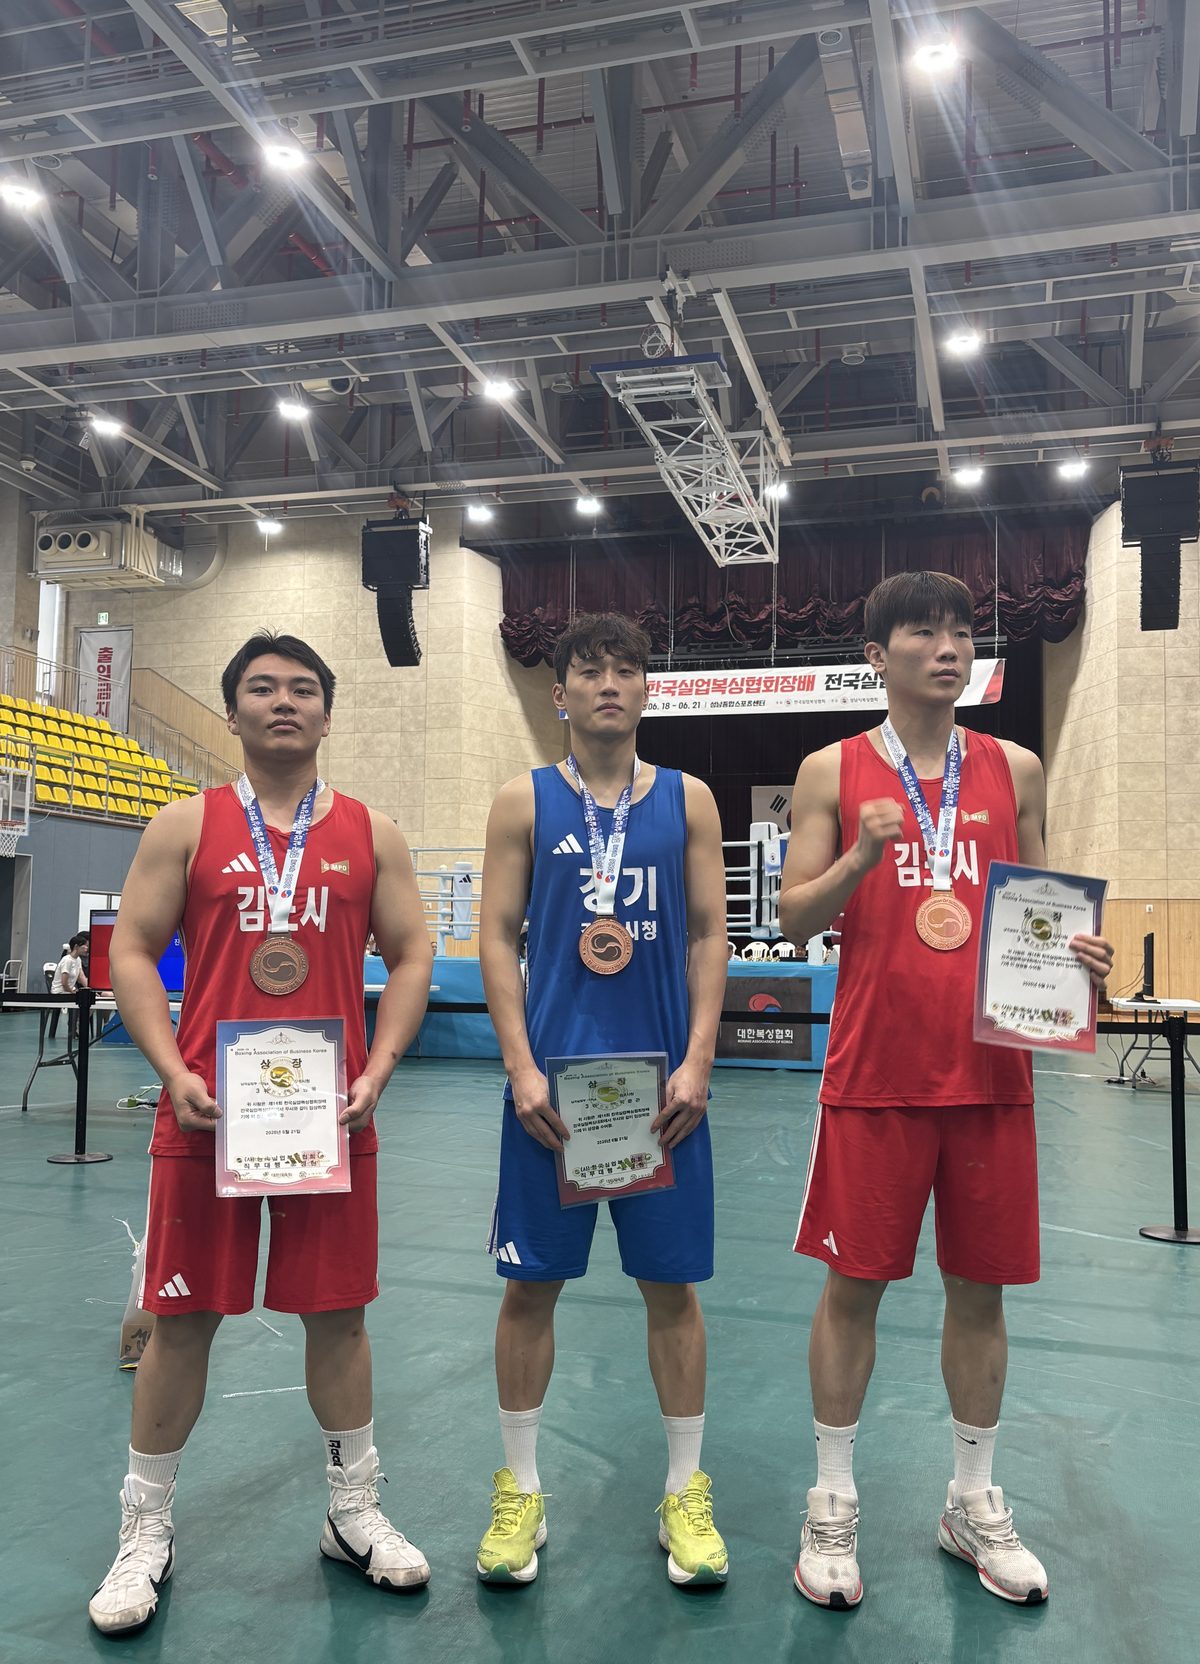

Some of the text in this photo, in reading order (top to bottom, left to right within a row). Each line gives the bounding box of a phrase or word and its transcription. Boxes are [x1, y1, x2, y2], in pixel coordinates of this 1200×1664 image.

[647, 675, 816, 697] 한국실업복싱협회장배
[237, 886, 328, 932] 김시
[737, 1029, 793, 1039] 대한복싱협회
[260, 1058, 302, 1069] 상 장
